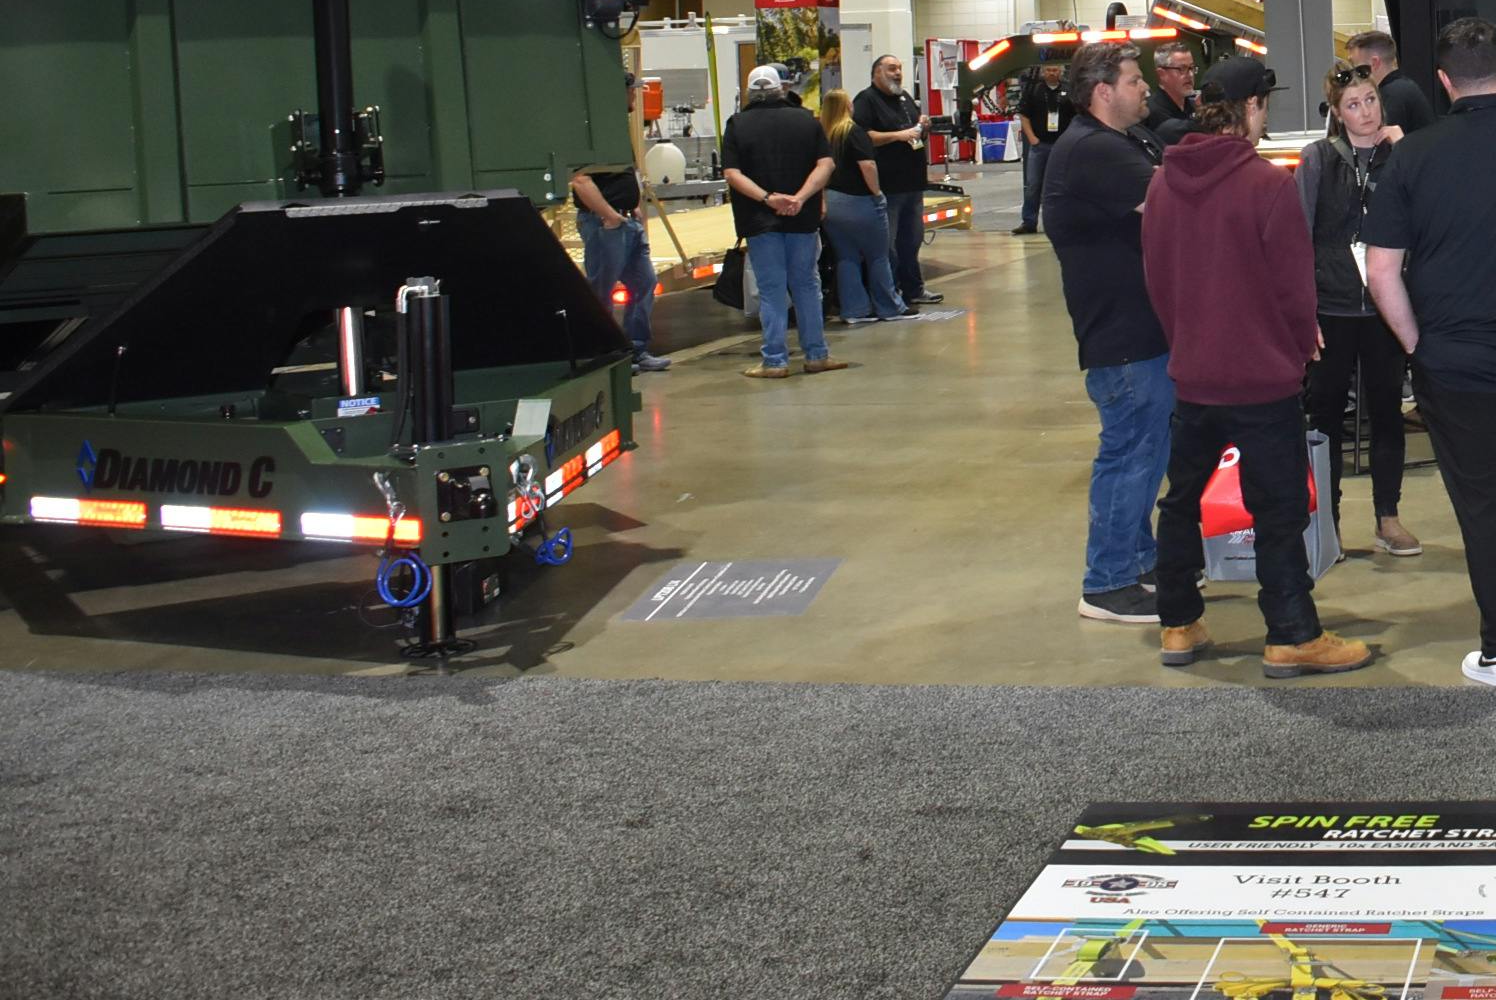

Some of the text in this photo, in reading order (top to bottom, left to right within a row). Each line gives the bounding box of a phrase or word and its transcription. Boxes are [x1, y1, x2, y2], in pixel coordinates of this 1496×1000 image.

[340, 397, 377, 408] NOTICE
[93, 448, 276, 498] DIAMOND C
[1247, 814, 1441, 829] SPIN FREE
[1323, 828, 1442, 840] RATCHET
[1237, 841, 1321, 849] FRIENDLY
[1233, 874, 1402, 885] Visit Booth
[1270, 888, 1351, 899] #547
[1090, 896, 1132, 904] USA
[1123, 907, 1486, 917] Also Offering Self Contained Ratchet Straps
